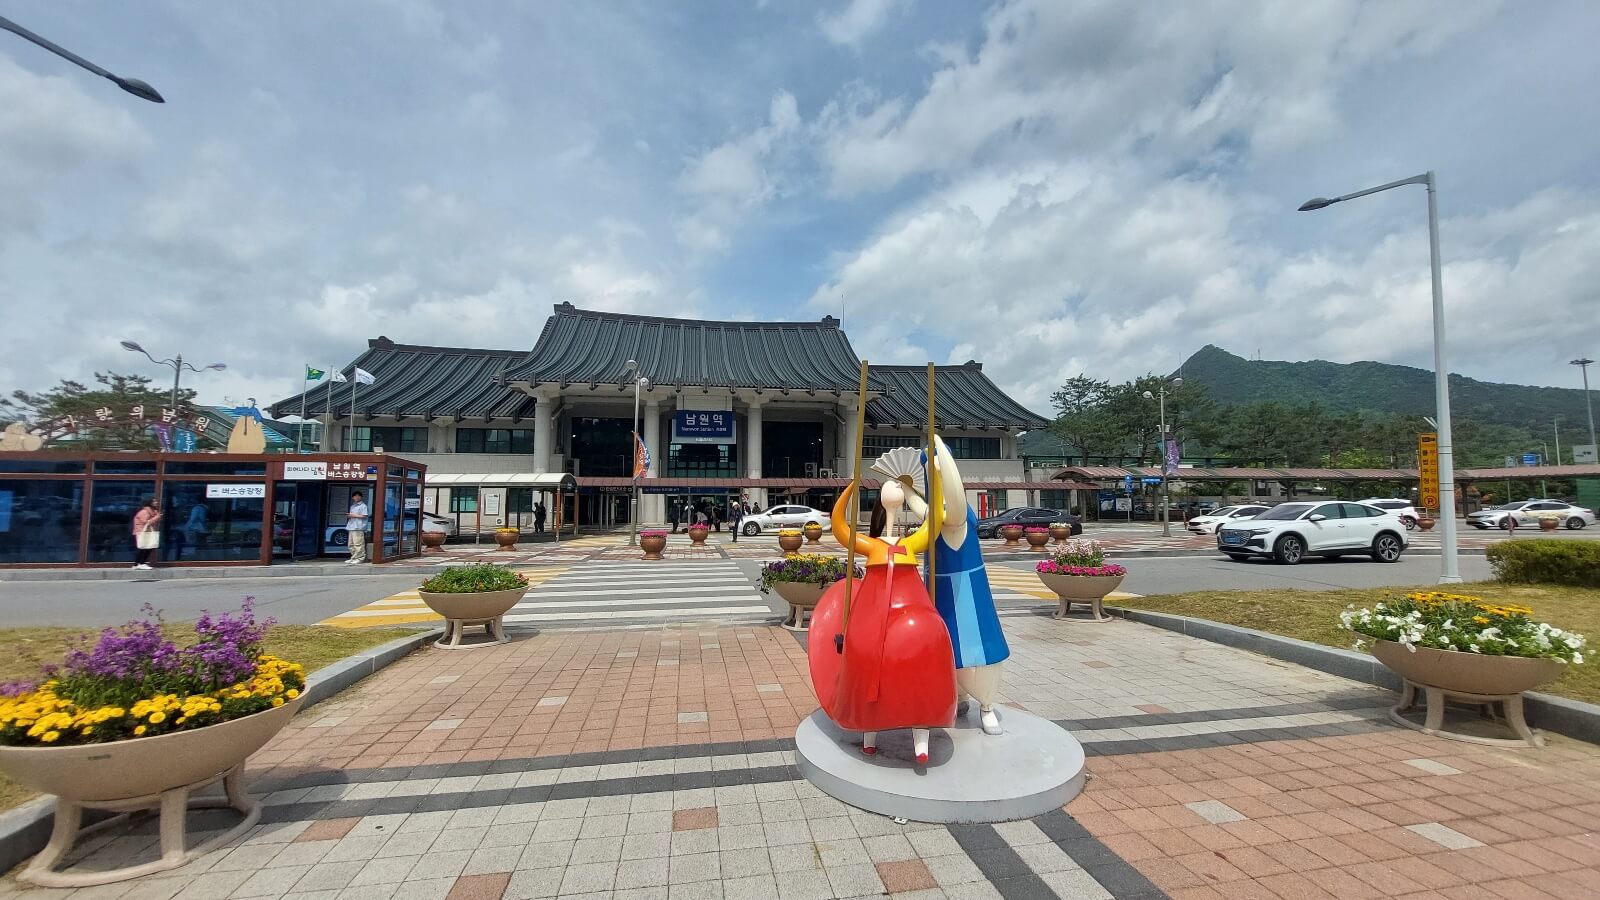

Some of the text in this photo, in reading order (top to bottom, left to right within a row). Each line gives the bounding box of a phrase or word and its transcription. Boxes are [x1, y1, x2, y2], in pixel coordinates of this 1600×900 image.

[686, 414, 723, 426] 남원역
[328, 471, 365, 479] 버스승강장
[222, 487, 263, 496] 버스승강장
